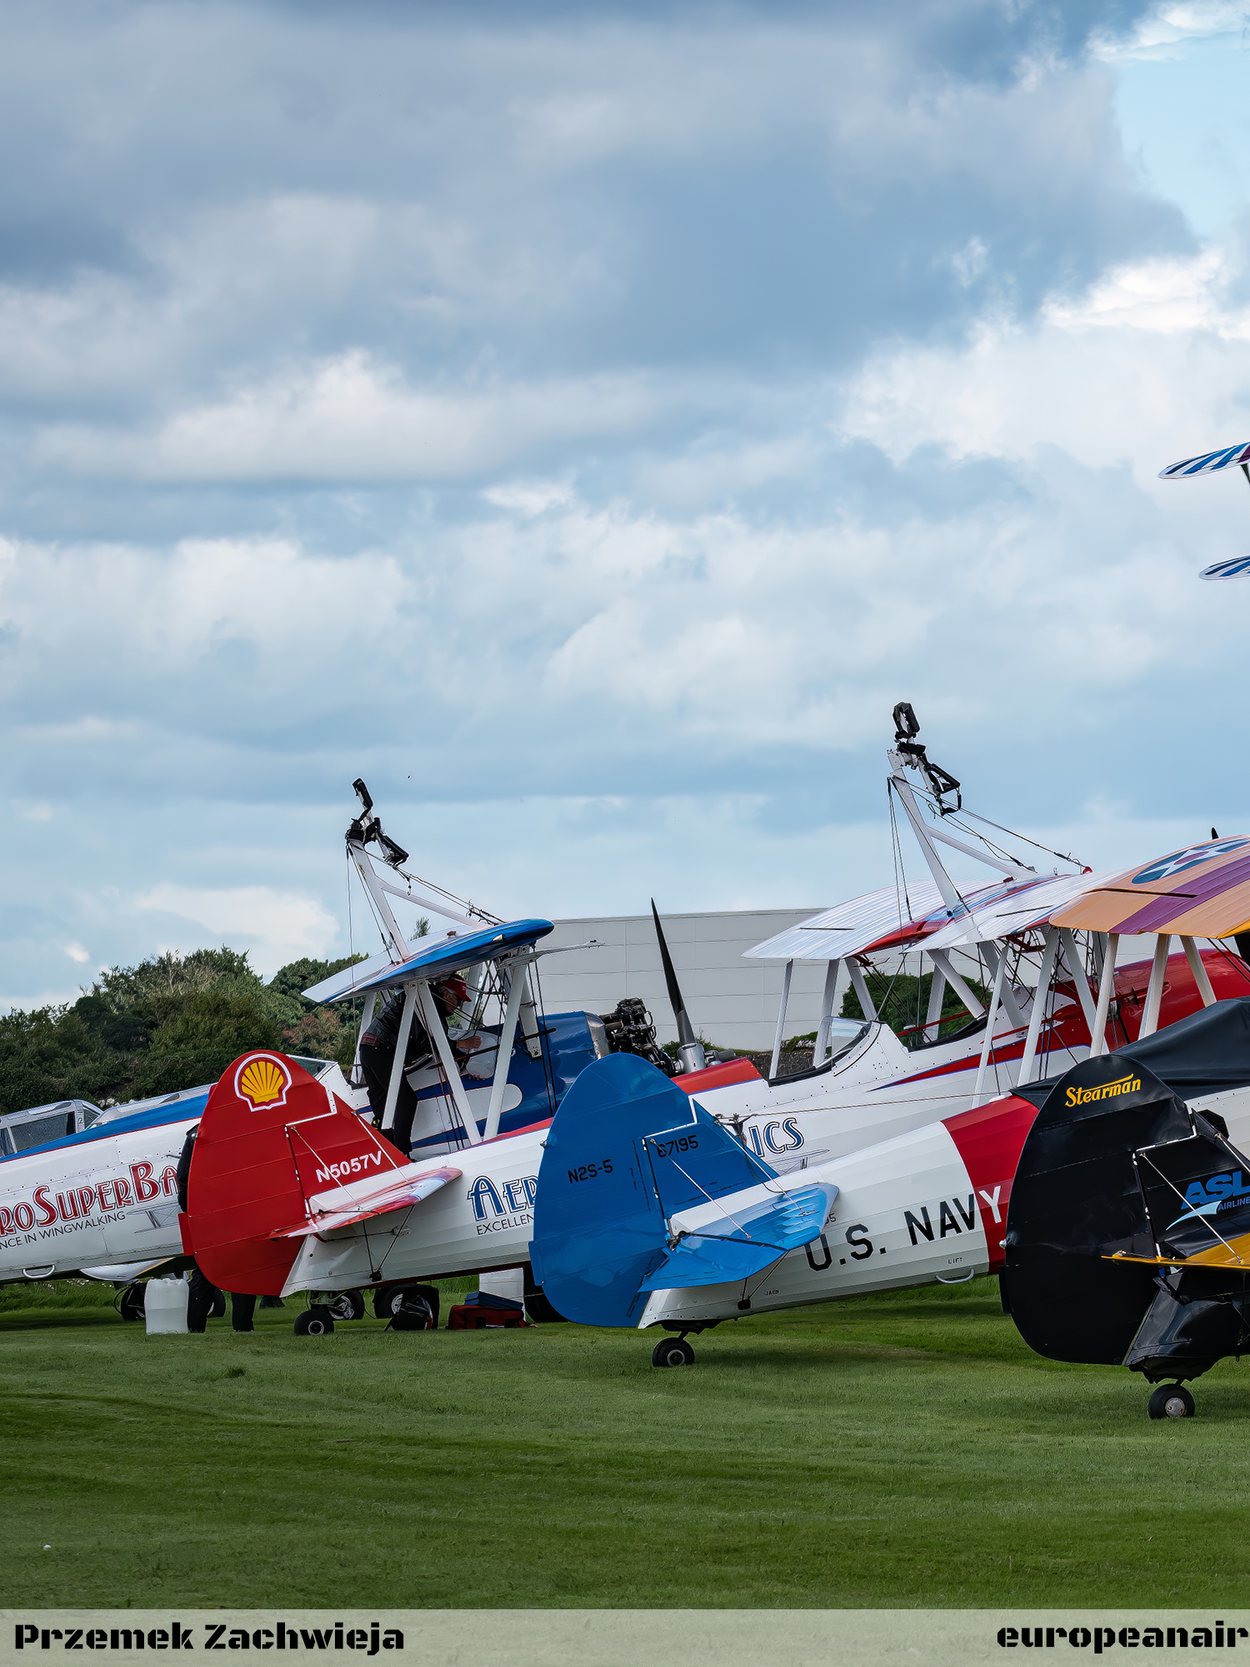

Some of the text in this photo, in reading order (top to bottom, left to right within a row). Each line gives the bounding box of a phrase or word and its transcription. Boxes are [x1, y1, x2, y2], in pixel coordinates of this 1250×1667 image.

[1065, 1073, 1142, 1108] Stearman
[657, 1134, 699, 1158] 67195
[315, 1150, 382, 1183] N5057V
[567, 1158, 613, 1185] N2S-5
[25, 1232, 37, 1244] IN
[40, 1211, 126, 1244] WINGWALKING
[804, 1185, 1002, 1272] U.S. NAVY
